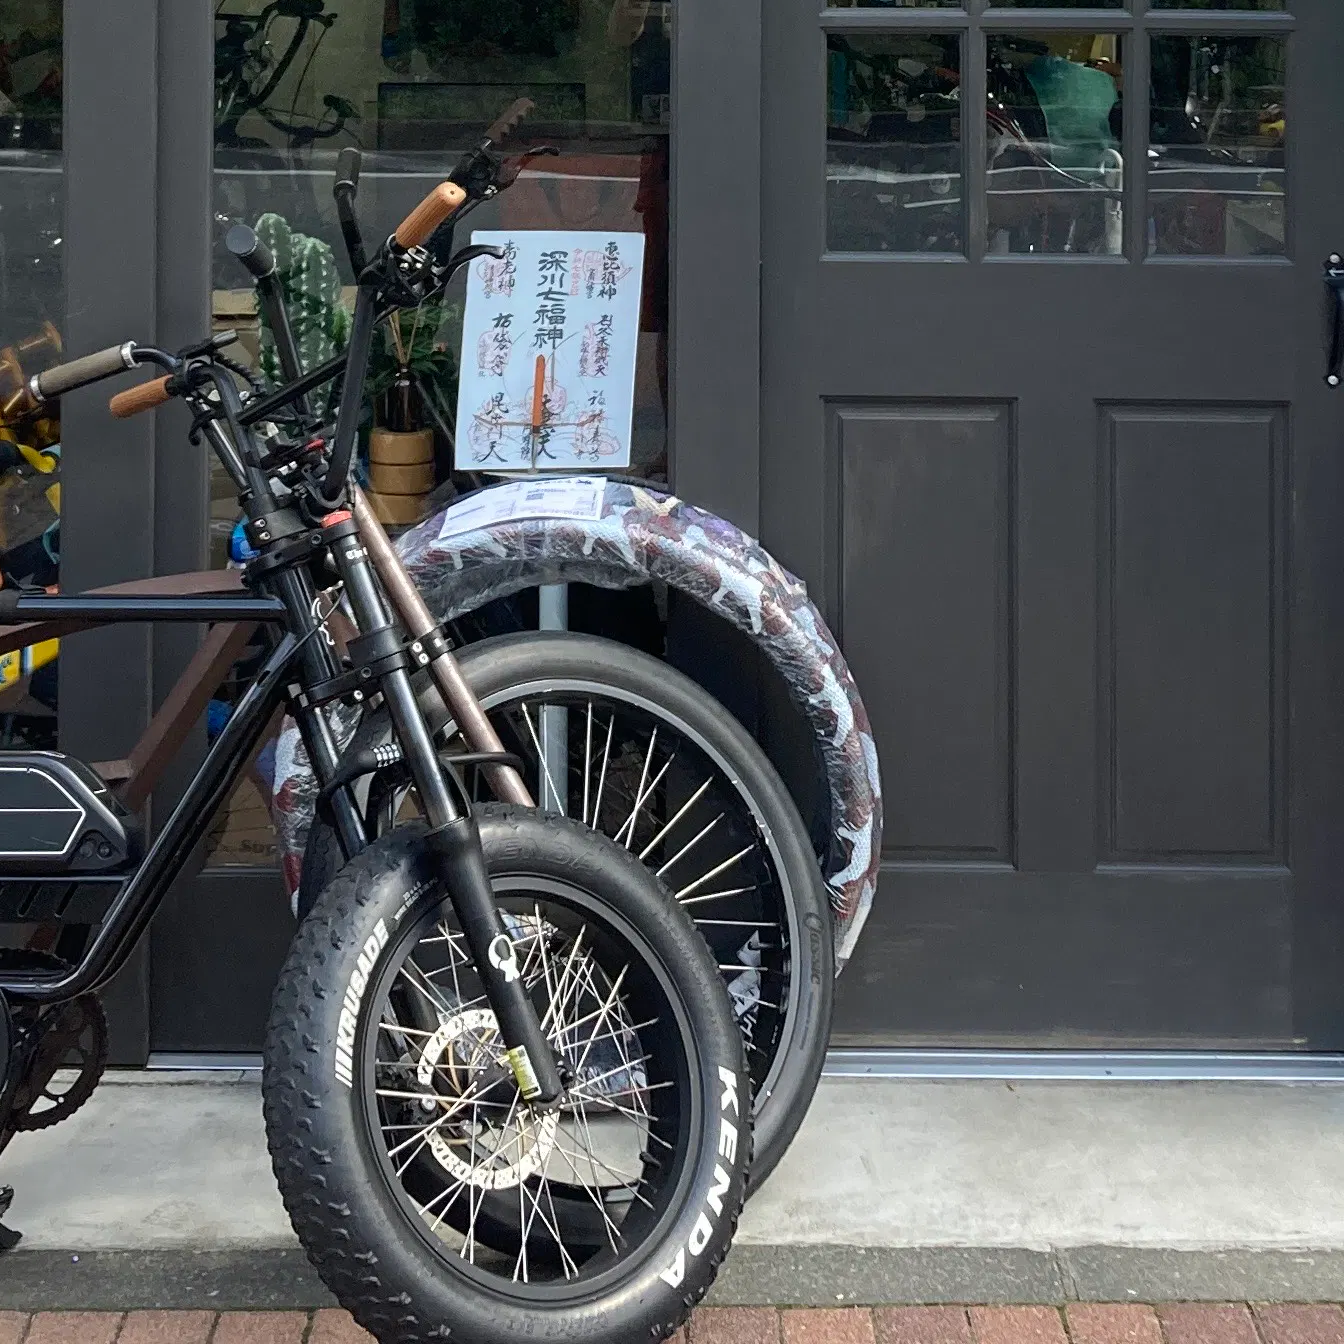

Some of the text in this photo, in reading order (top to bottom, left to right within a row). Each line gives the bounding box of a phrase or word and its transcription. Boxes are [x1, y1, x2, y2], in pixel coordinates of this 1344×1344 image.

[532, 250, 570, 350] 深川七福神
[336, 917, 389, 1054] KRUSADE
[658, 1064, 739, 1290] KENDA
